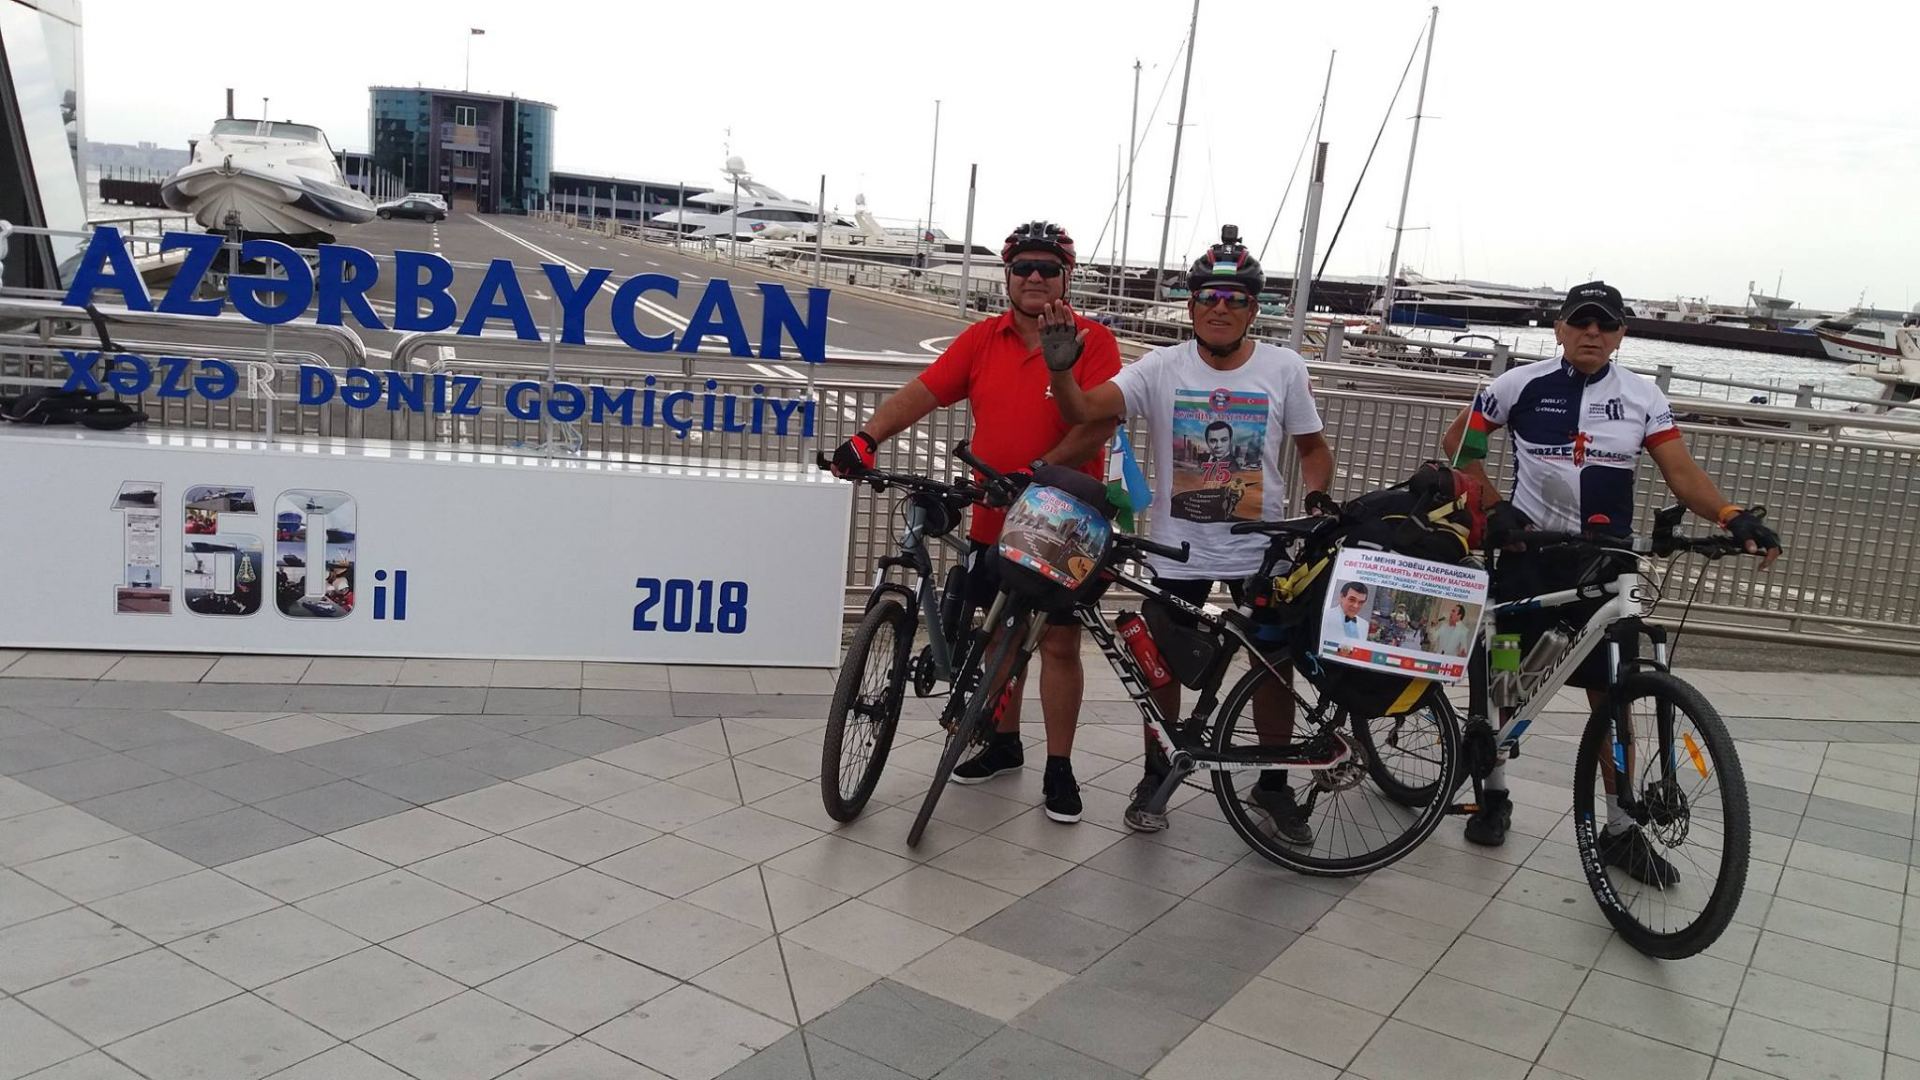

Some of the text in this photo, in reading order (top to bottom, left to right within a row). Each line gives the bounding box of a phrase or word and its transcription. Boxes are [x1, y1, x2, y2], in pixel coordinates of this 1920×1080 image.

[63, 226, 832, 363] AZƏRBAYCAN
[60, 350, 279, 401] XƏZƏR
[1200, 461, 1232, 484] 75
[110, 480, 358, 623] 160
[373, 569, 407, 621] il
[1374, 556, 1396, 565] МЕНЯ
[632, 577, 749, 634] 2018
